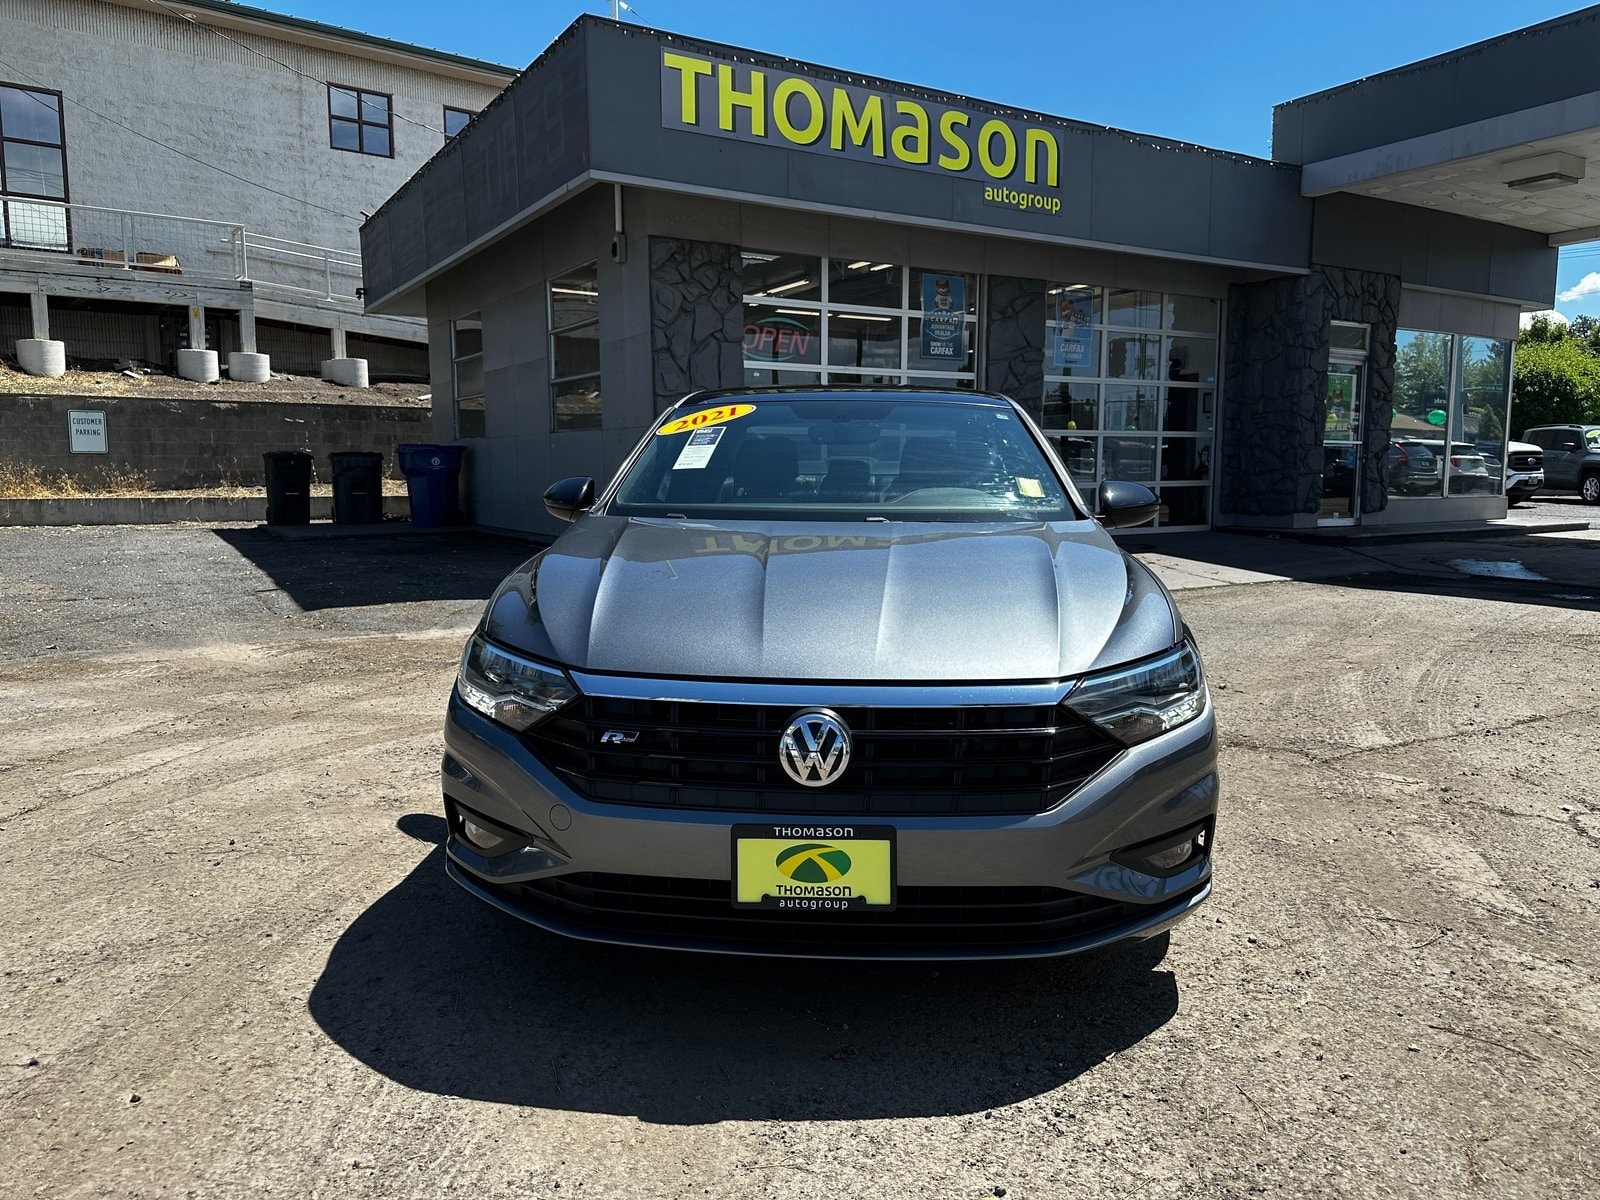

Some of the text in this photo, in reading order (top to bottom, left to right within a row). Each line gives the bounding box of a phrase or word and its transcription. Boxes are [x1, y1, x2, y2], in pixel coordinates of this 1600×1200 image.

[983, 184, 1062, 214] autogroup
[742, 324, 810, 355] OPEN
[930, 346, 954, 356] CARFAX
[1060, 343, 1086, 353] CARFAX
[73, 417, 102, 425] CUSTOMER
[675, 407, 737, 431] 2021
[76, 428, 100, 436] PARKING
[779, 899, 849, 910] autogroup
